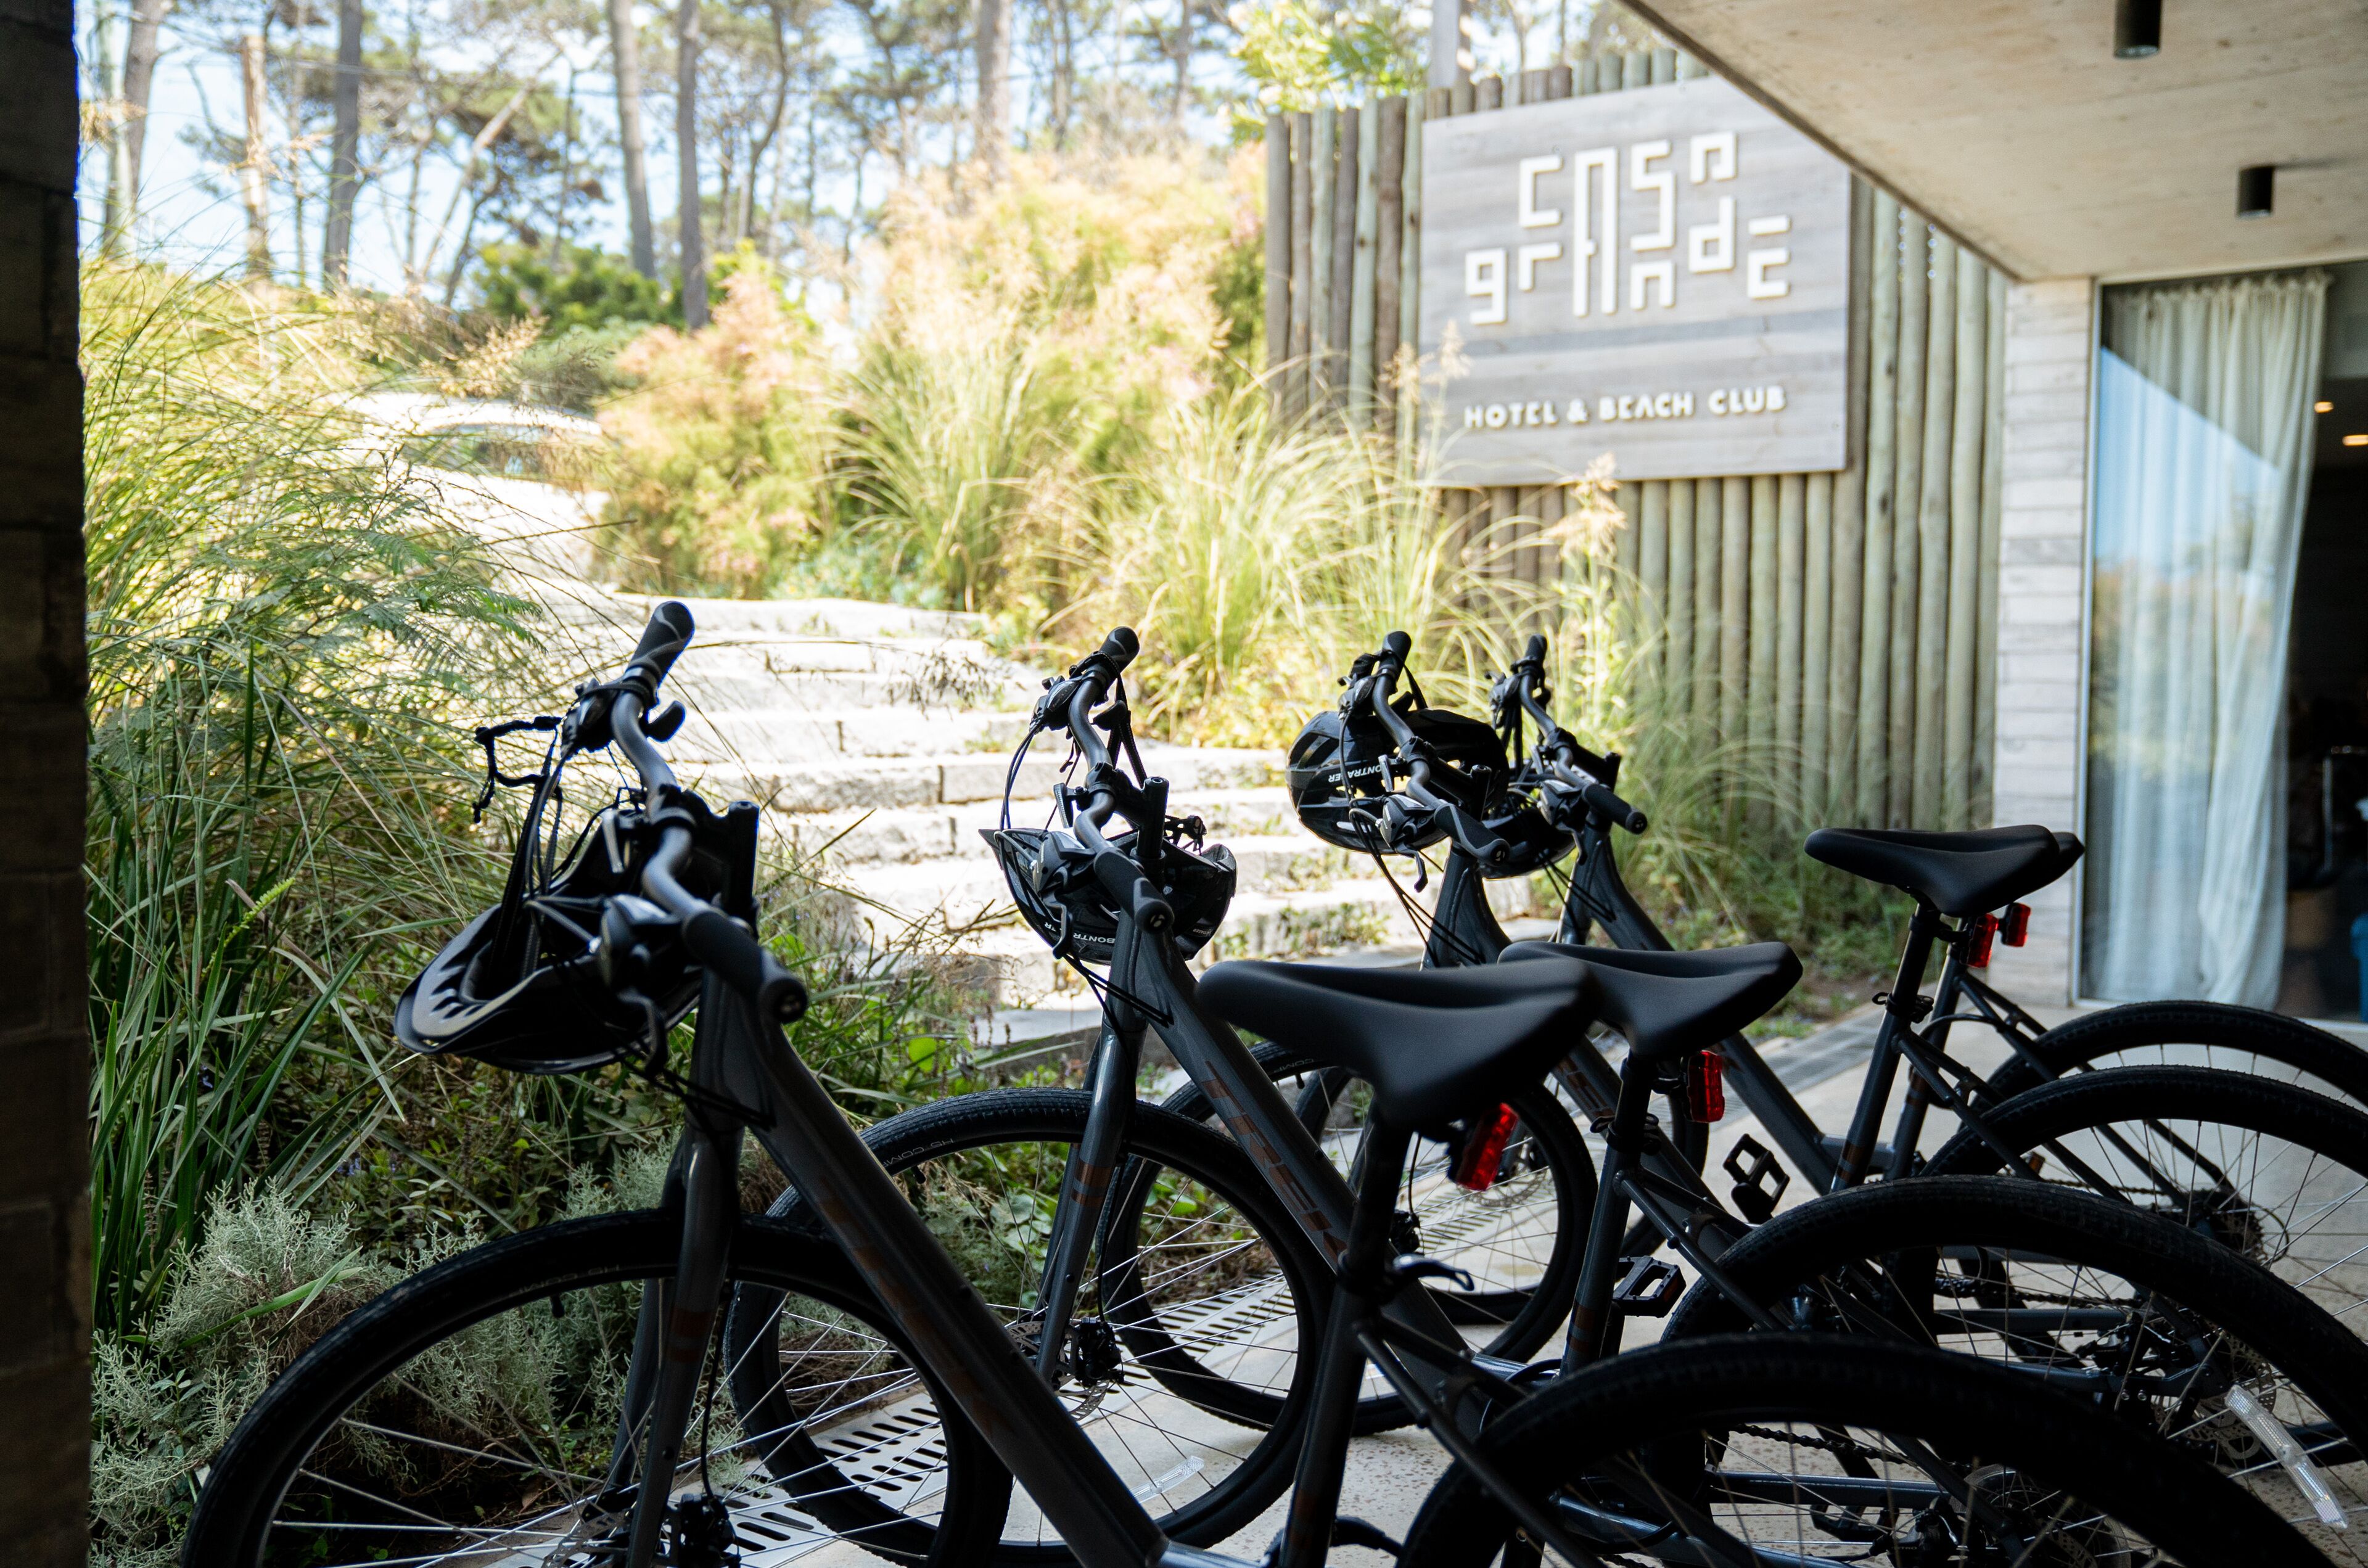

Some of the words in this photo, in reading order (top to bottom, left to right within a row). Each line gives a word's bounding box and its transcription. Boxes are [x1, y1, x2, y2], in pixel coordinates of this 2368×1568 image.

[1464, 401, 1560, 429] HOTEL
[1567, 398, 1589, 424] &
[1598, 391, 1695, 422] BEACH
[1708, 385, 1787, 416] CLUB
[1328, 765, 1382, 782] ONTRAER
